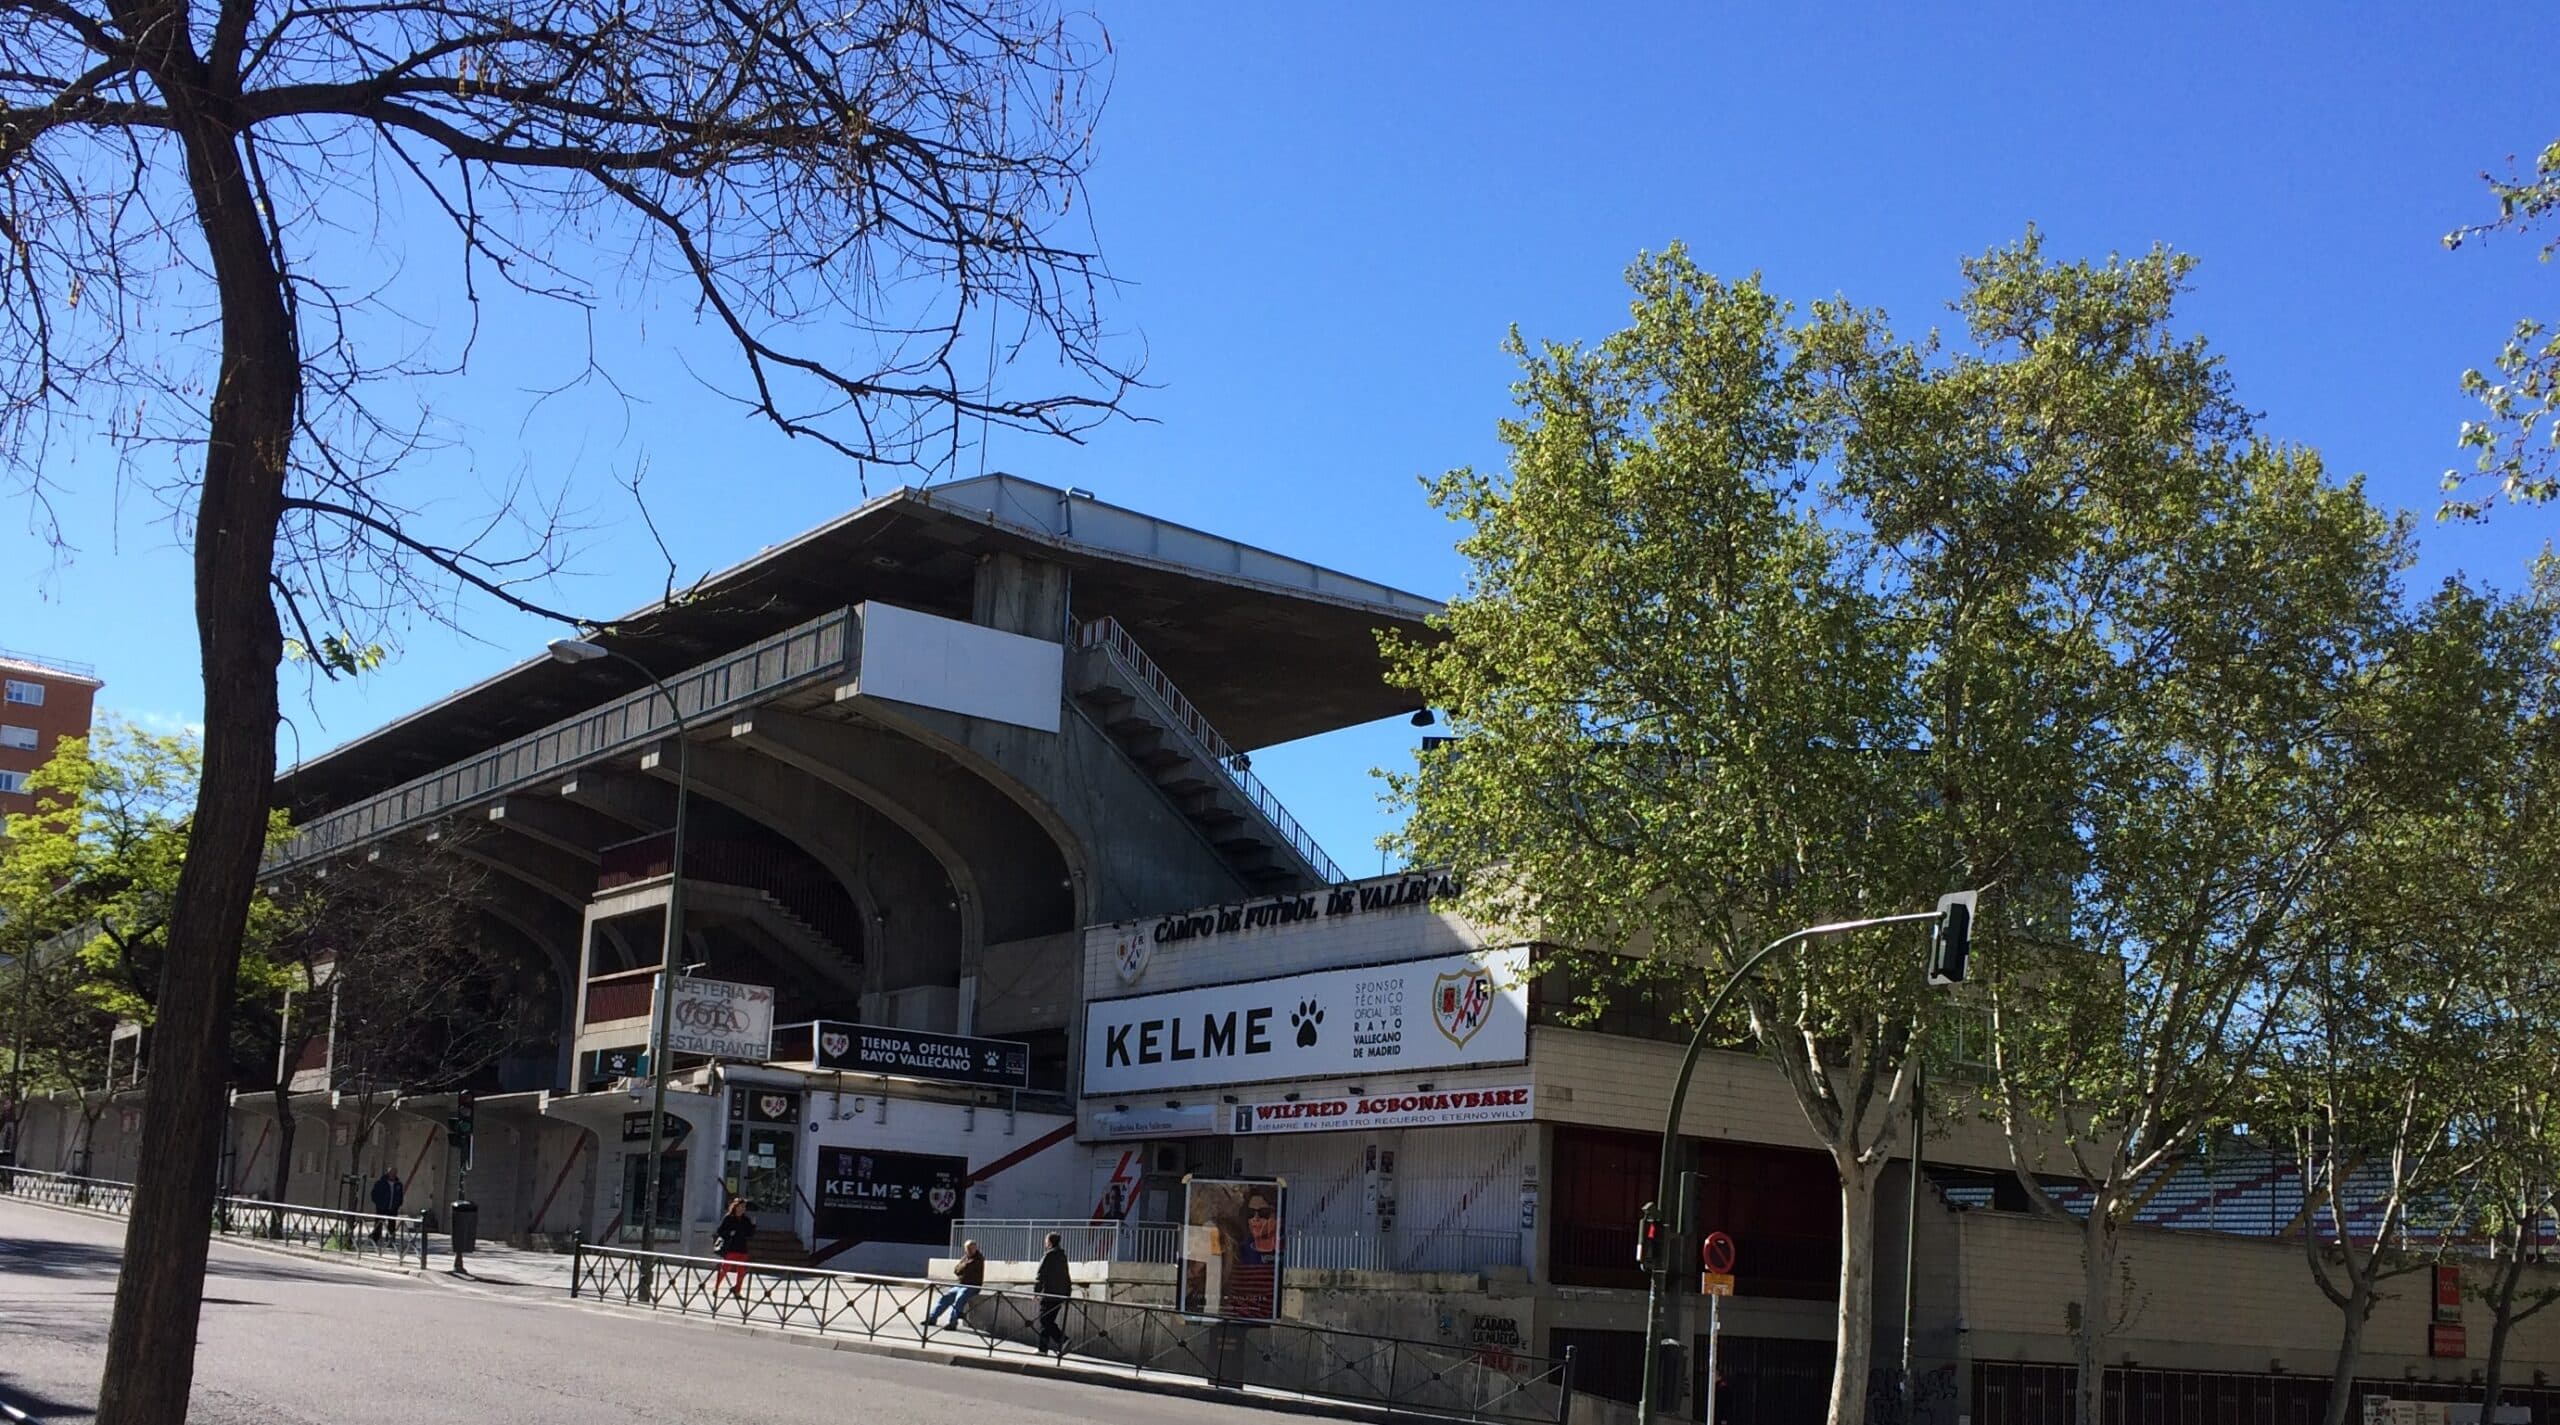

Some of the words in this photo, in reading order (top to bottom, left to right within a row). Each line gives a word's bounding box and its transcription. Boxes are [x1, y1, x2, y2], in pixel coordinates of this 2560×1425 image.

[1154, 914, 1214, 943] CAMPO
[1216, 907, 1243, 933] DE
[1244, 896, 1318, 929] FUTBOL
[1326, 889, 1355, 915] DE
[1355, 978, 1404, 994] SPONSOR
[1355, 992, 1403, 1007] TÉCNICO
[1354, 1007, 1383, 1020] OFICIAL
[1389, 1004, 1403, 1017] DEL
[861, 1036, 911, 1053] TIENDA
[918, 1042, 971, 1059] OFICIAL
[1106, 1007, 1273, 1068] KELME
[1353, 1031, 1402, 1046] VALLECANO
[860, 1050, 896, 1064] RAYO
[899, 1053, 971, 1072] VALLECANO
[1353, 1048, 1364, 1059] DE
[1367, 1045, 1401, 1058] MADRID
[1256, 1101, 1348, 1120] WILFRED
[1355, 1088, 1529, 1115] AGBONAVBARE
[1257, 1121, 1298, 1131] SIEMPRE
[1303, 1120, 1317, 1129] EN
[1321, 1118, 1370, 1129] NUESTRO
[1374, 1115, 1436, 1125] RECUERDO
[1442, 1111, 1488, 1121] ETERNO
[1491, 1110, 1526, 1119] WILLY
[825, 1178, 903, 1199] KELME
